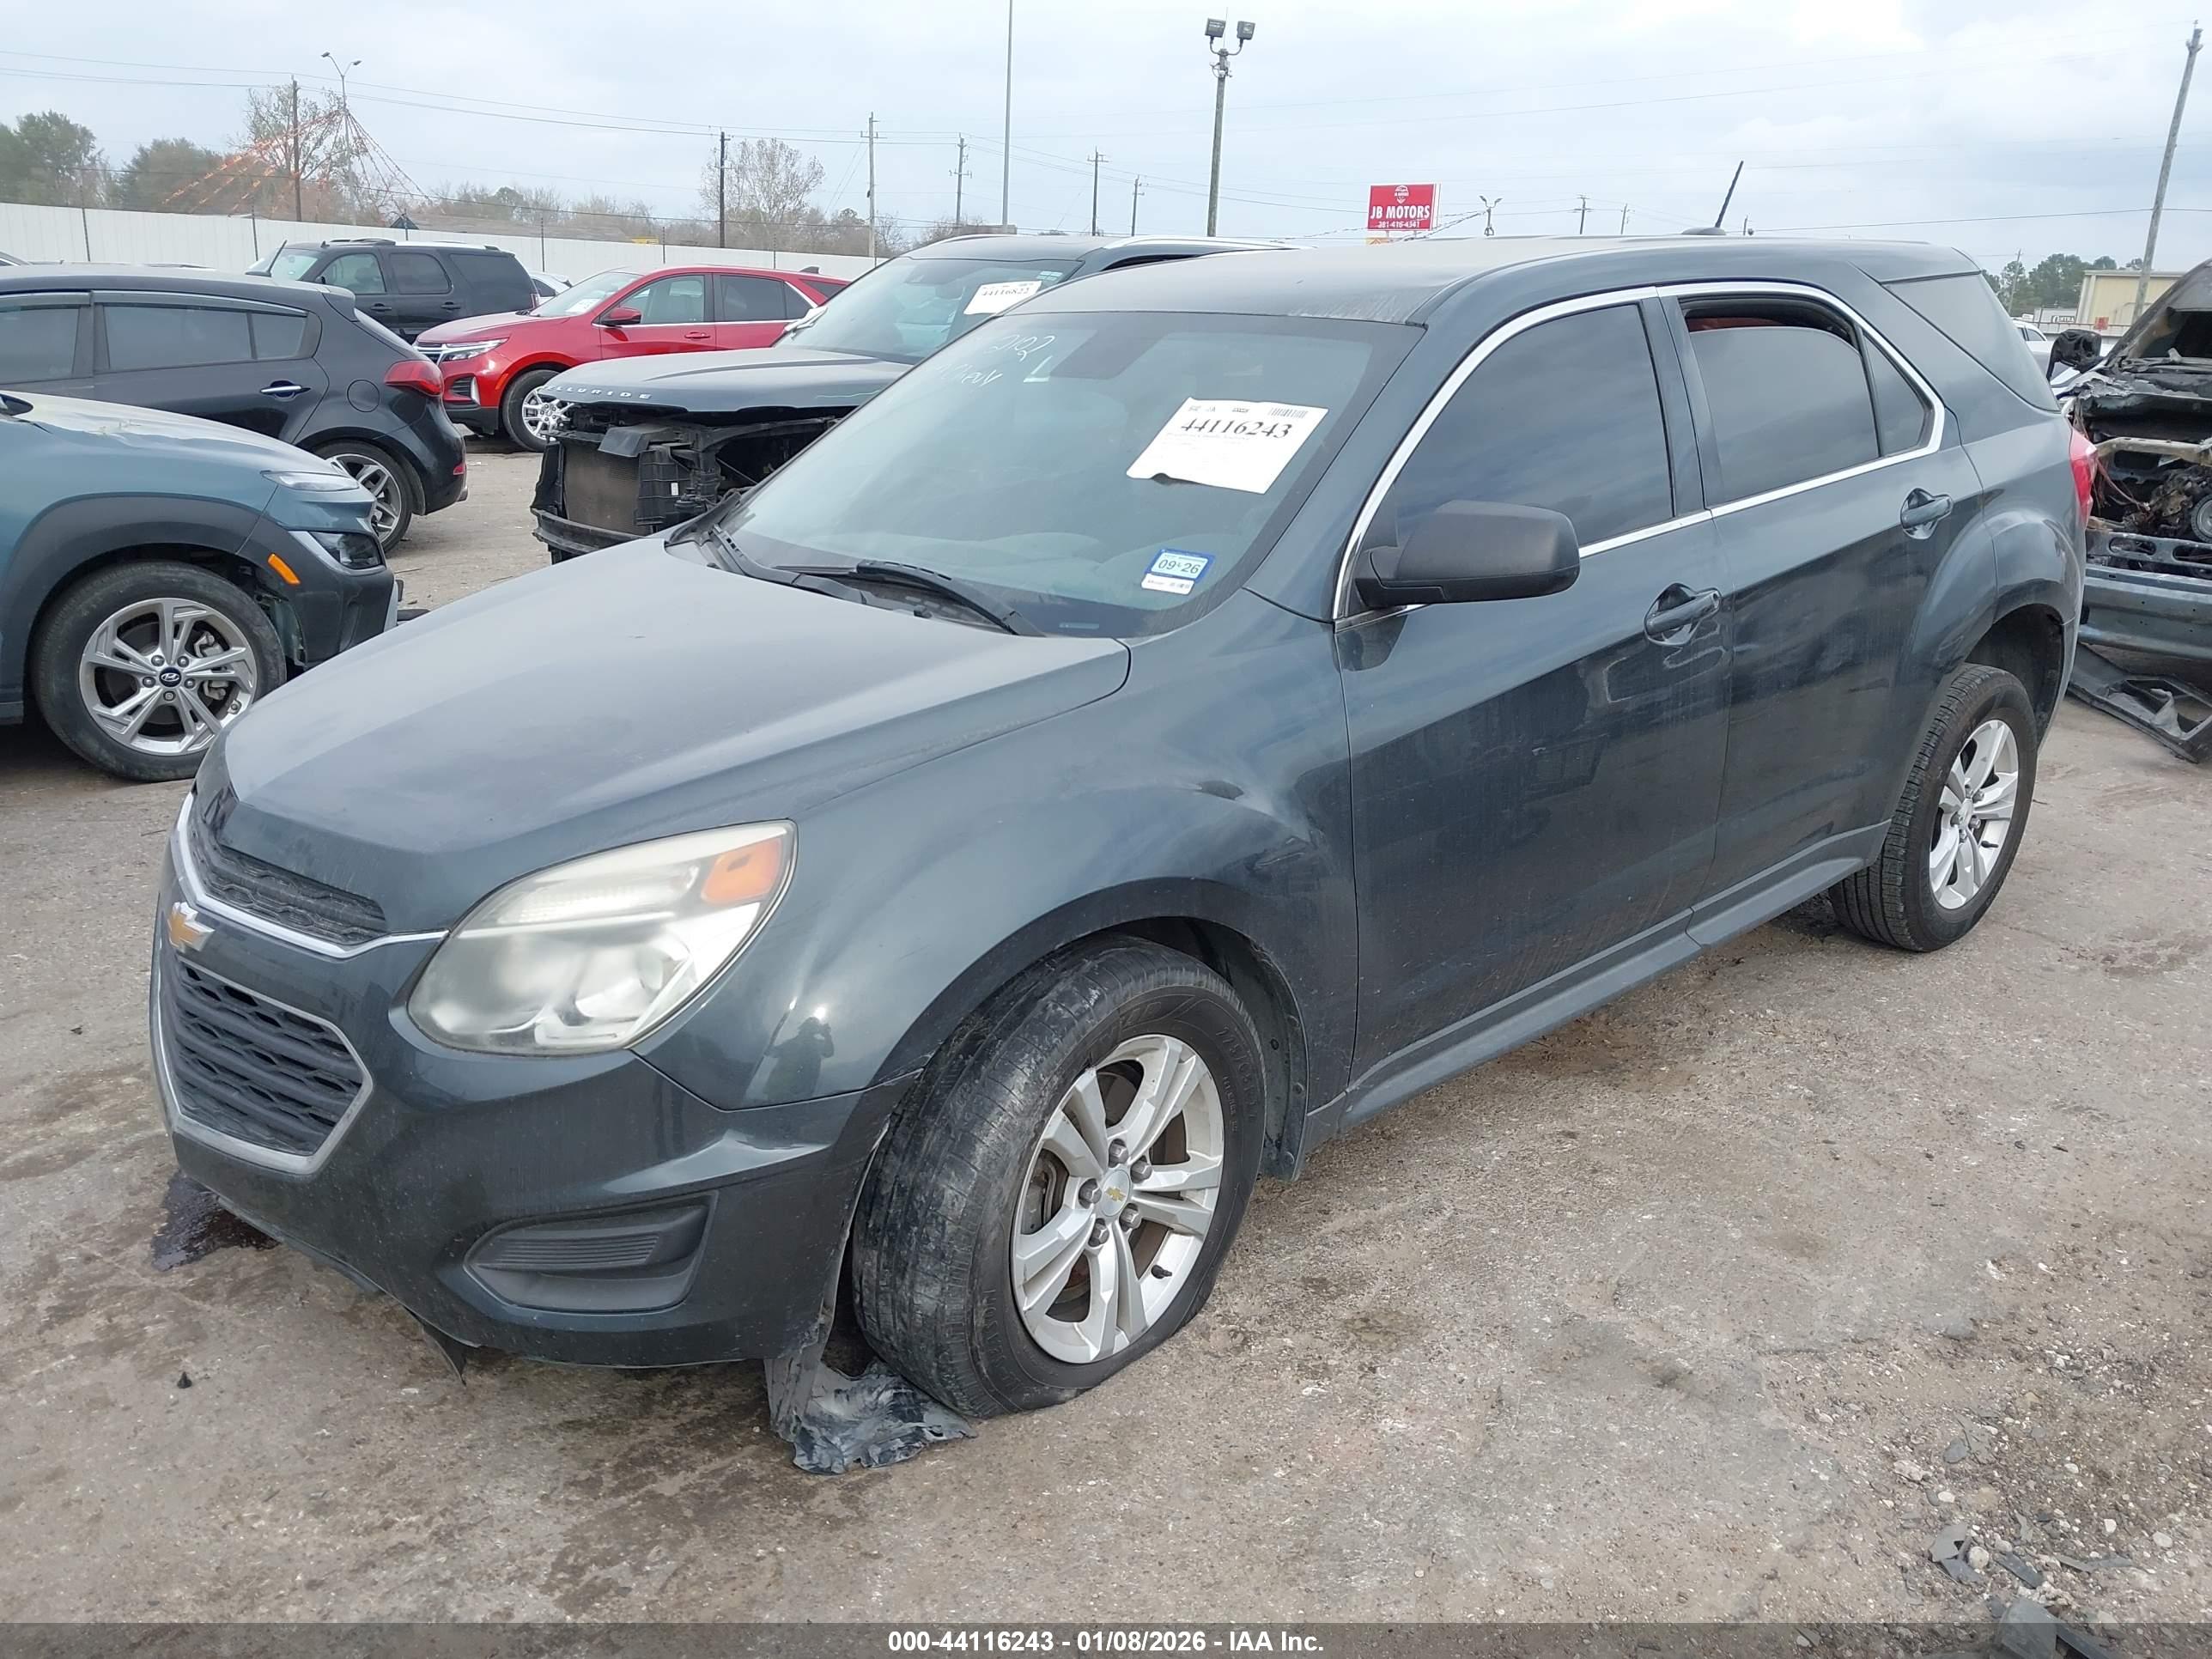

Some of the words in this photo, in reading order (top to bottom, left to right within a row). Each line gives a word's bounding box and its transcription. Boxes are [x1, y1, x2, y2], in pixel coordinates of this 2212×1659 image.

[1370, 206, 1382, 219] JB
[1386, 205, 1431, 219] MOTORS
[1181, 418, 1292, 439] 44116243
[1158, 559, 1176, 570] 09
[1181, 562, 1201, 574] 26
